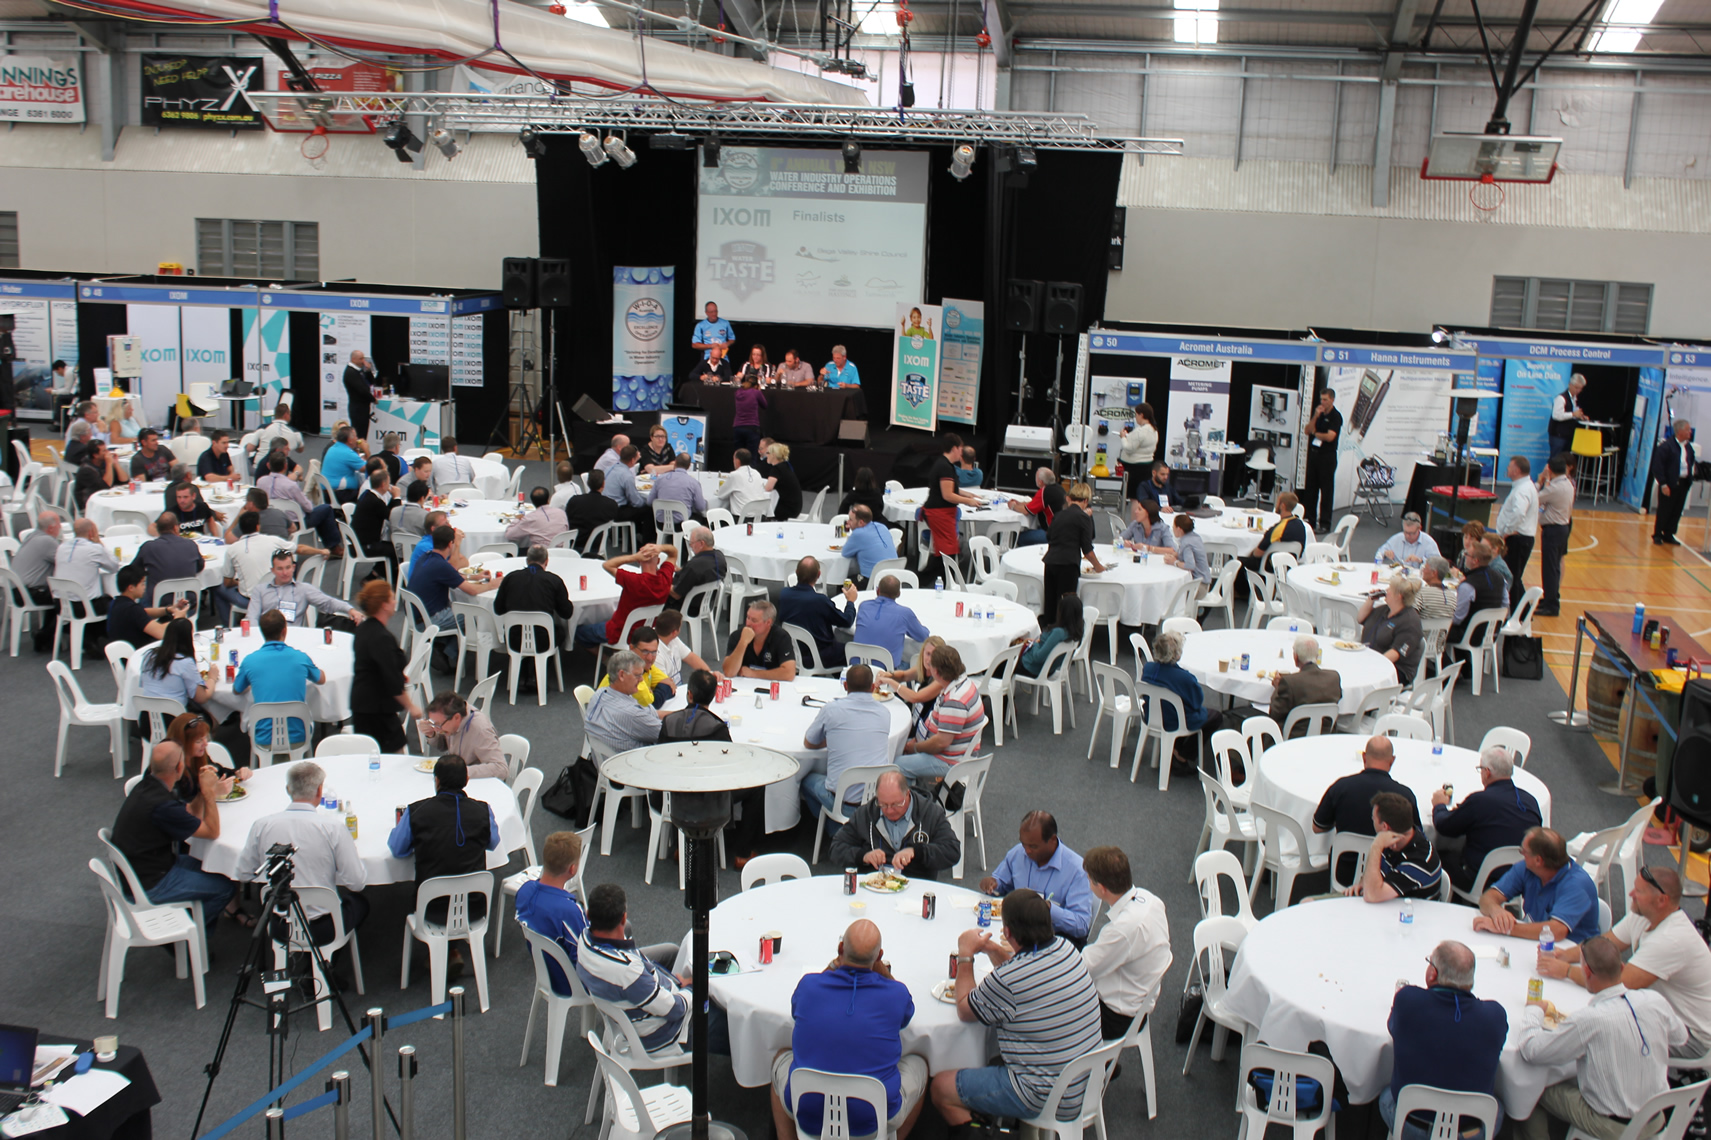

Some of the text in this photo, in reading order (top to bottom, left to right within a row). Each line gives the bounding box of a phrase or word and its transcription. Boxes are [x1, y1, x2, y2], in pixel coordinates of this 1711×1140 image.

[153, 74, 179, 86] NEED
[314, 72, 342, 80] PIZZA
[785, 158, 832, 172] ANNUAL
[868, 160, 896, 175] NSW
[769, 171, 897, 186] WATER INDUSTRY OPERATIONS
[769, 181, 897, 196] CONFERENCE AND EXHIBITION
[713, 207, 771, 227] IXOM
[793, 210, 845, 223] Finalists
[709, 258, 774, 282] TASTE
[350, 299, 369, 309] IXOM
[1106, 337, 1118, 347] 50
[1179, 341, 1253, 355] Acromet Australia
[140, 348, 176, 362] XOM
[185, 348, 225, 363] IXOM
[1338, 350, 1349, 360] 51
[1529, 345, 1611, 359] DCM Process Control
[1684, 353, 1696, 364] 53
[903, 354, 930, 367] IXOM
[1176, 358, 1226, 368] ACROMET
[1370, 352, 1451, 366] Hanna Instruments
[1516, 369, 1562, 380] On Line Data
[900, 382, 929, 398] TASTE
[179, 518, 205, 530] OAKLEY
